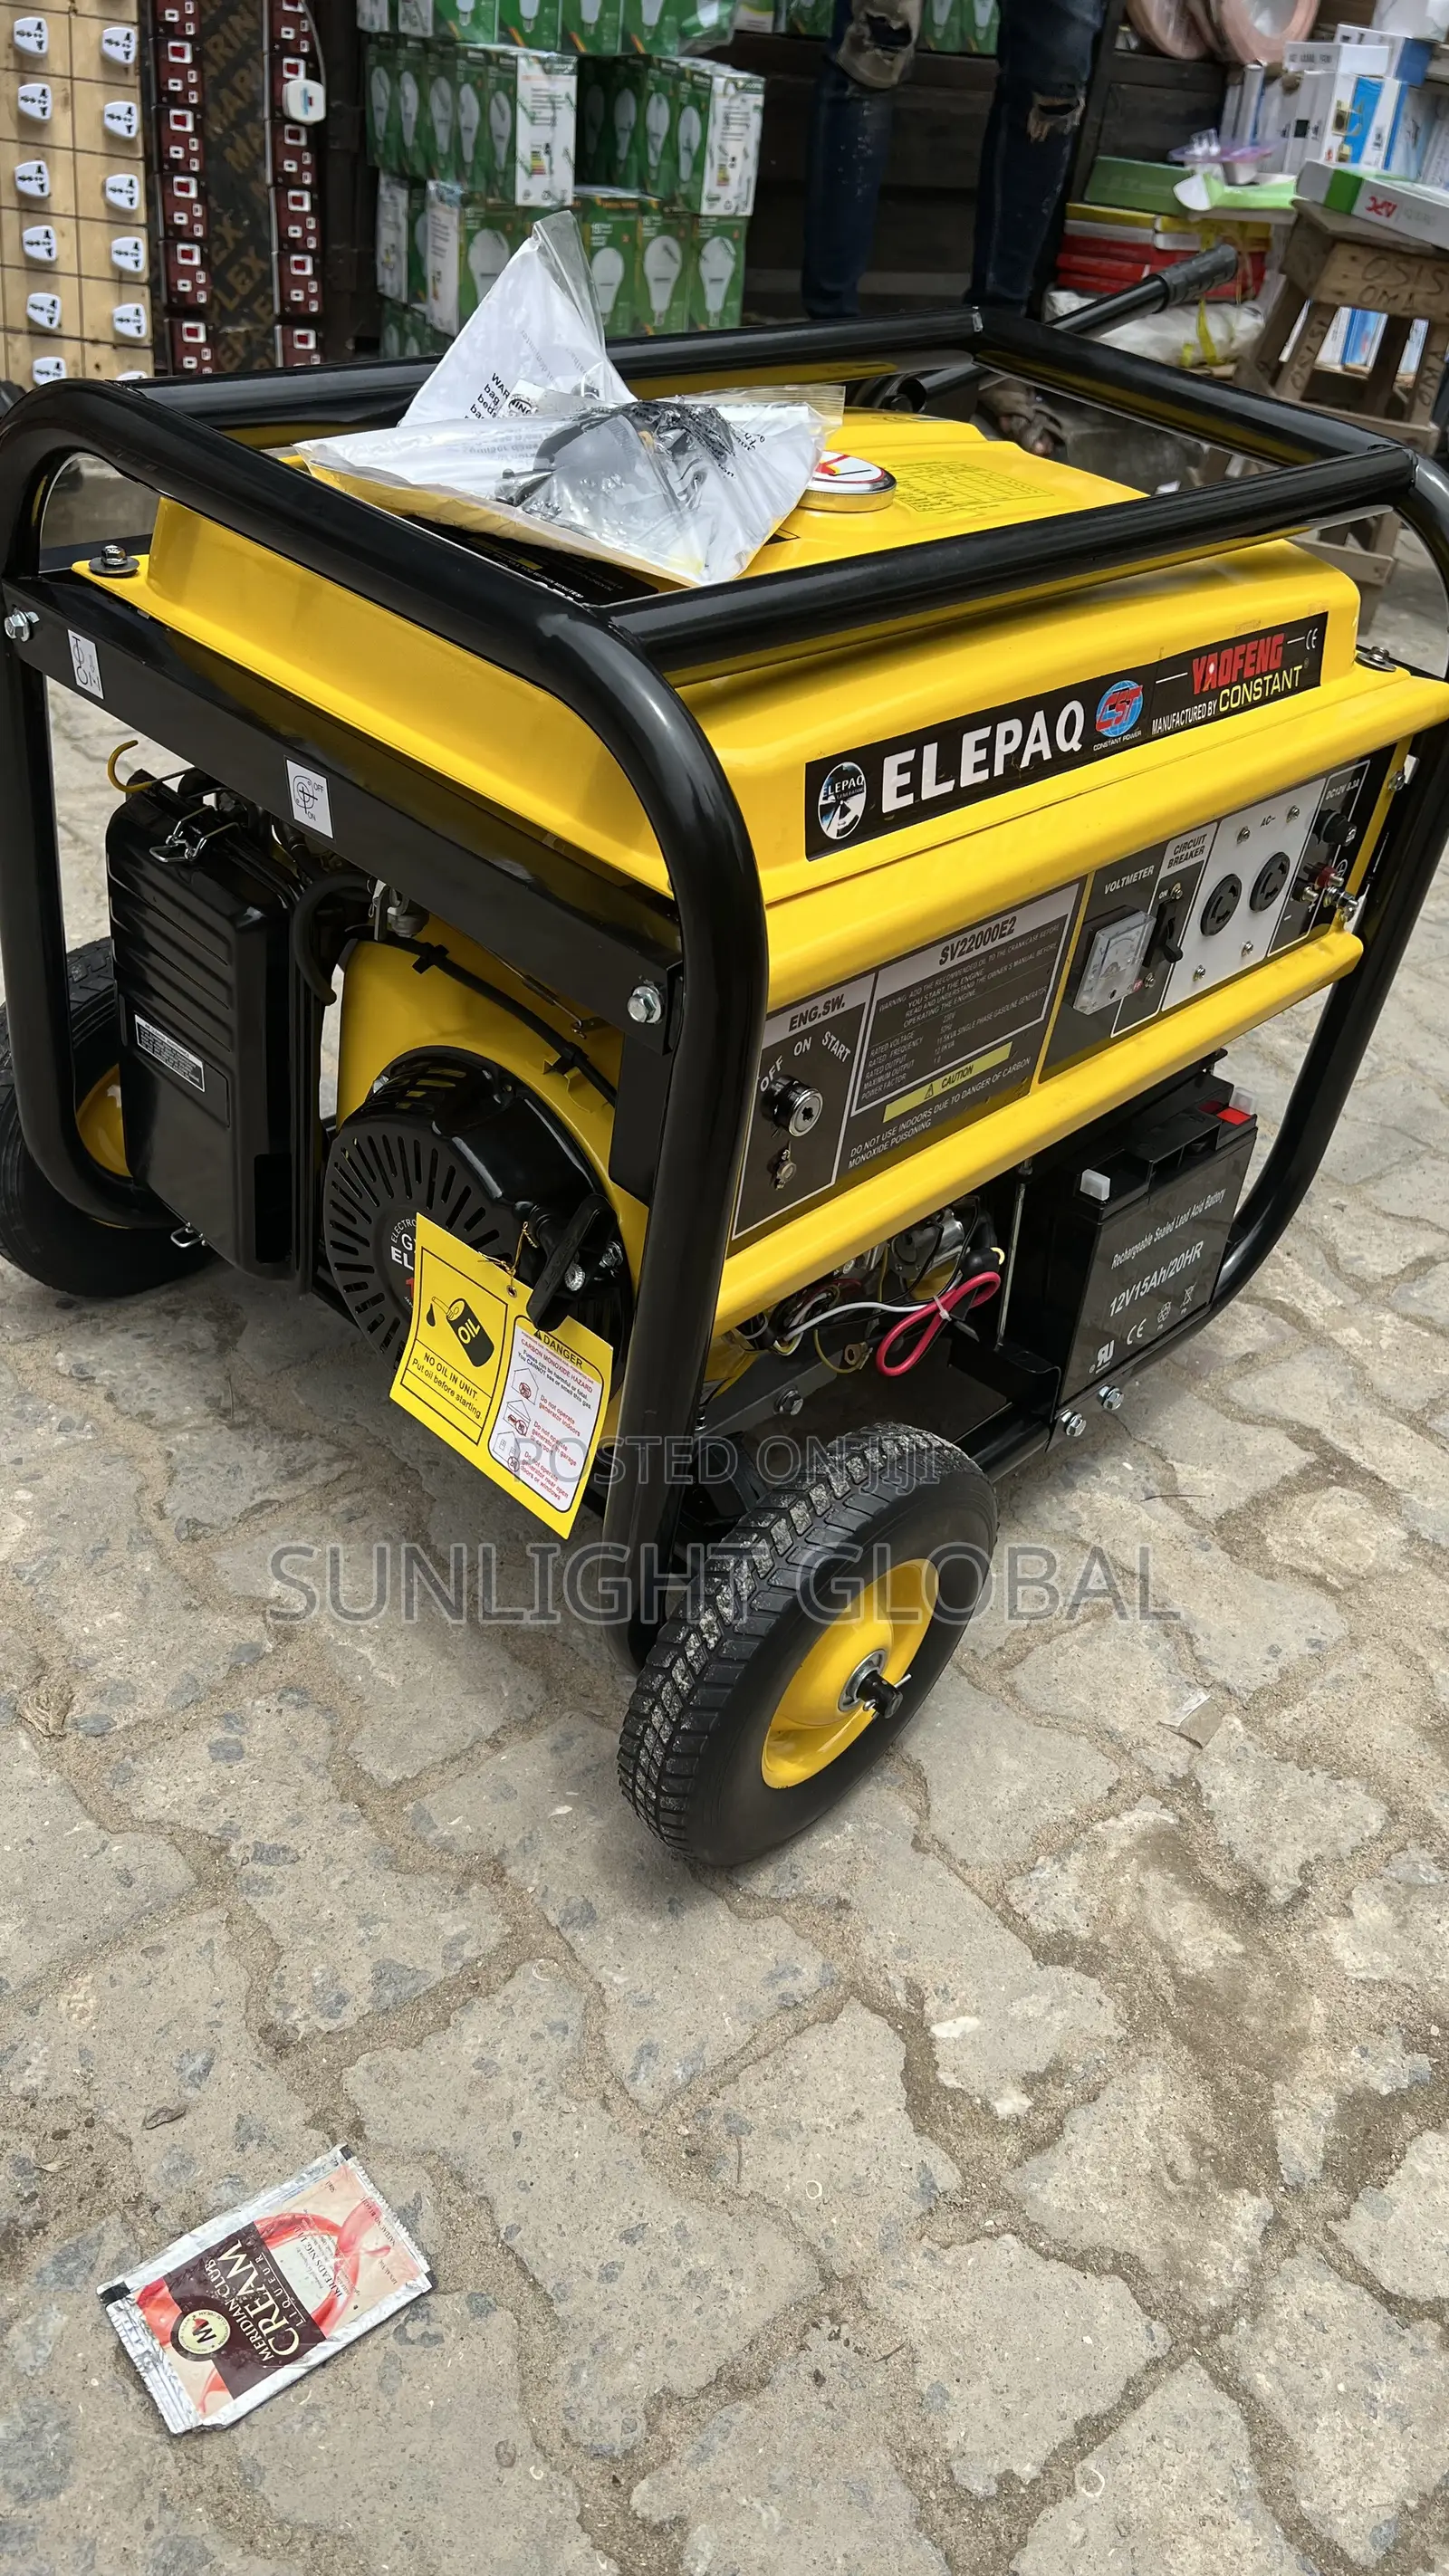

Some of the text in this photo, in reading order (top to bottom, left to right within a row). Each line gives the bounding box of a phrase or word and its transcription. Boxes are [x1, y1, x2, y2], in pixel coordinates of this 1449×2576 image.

[1192, 633, 1285, 694] YAOFENG
[1152, 665, 1302, 735] MANUFACTURED BY CONSTANT
[881, 700, 1085, 813] ELEPAQ
[1093, 730, 1141, 752] CONSTANT POWER
[313, 782, 324, 793] OFF
[823, 774, 864, 797] ELEPAQ
[308, 811, 316, 821] ON
[1167, 846, 1205, 869] BREAKER
[1173, 834, 1207, 856] CIRCUIT
[1105, 865, 1155, 895] VOLTMETER
[1159, 889, 1168, 899] ON
[939, 916, 1016, 965] SV22000E2
[906, 1005, 922, 1018] READ
[923, 999, 936, 1010] AND
[936, 982, 975, 1005] UNDERSTAND
[976, 975, 987, 986] THE
[908, 995, 924, 1008] YOU
[924, 988, 945, 1003] START
[947, 982, 959, 993] THE
[788, 993, 845, 1032] ENG.SW.
[904, 1006, 940, 1028] OPERATING
[941, 1001, 952, 1011] THE
[793, 1037, 812, 1057] ON
[821, 1030, 851, 1062] START
[865, 1067, 884, 1079] RATED
[885, 1054, 907, 1070] OUTPUT
[956, 1021, 975, 1038] SINGLE
[976, 1013, 993, 1027] PHASE
[870, 1045, 888, 1058] RATED
[889, 1031, 916, 1049] VOLTAGE
[890, 1037, 924, 1058] FREQUENCY
[760, 1055, 783, 1092] OFF
[863, 1059, 915, 1089] MAXIMUM OUTPUT
[883, 1073, 907, 1090] FACTOR
[941, 1064, 974, 1089] CAUTION
[850, 1056, 1032, 1158] DO NOT USE INDOORS DUE TO DANGER OF CARBON
[848, 1119, 932, 1169] MONOXIDE POISONING
[1111, 1188, 1227, 1269] Rechargeable Sealed Lead Acid Battery
[1110, 1240, 1204, 1317] 12V15Ah/20HR
[457, 1318, 481, 1345] OIL
[521, 1338, 593, 1393] CARBON MONOXIDE HAZARD
[523, 1349, 538, 1364] Fumes
[547, 1365, 553, 1374] be
[553, 1370, 571, 1387] harmful
[543, 1335, 583, 1369] DANGER
[411, 1358, 424, 1373] Put
[424, 1365, 435, 1379] oil
[433, 1372, 456, 1398] before
[424, 1352, 435, 1365] NO
[436, 1360, 449, 1378] OIL
[449, 1373, 458, 1386] IN
[526, 1358, 546, 1376] CANNOT
[546, 1374, 555, 1383] see
[561, 1384, 572, 1397] smell
[573, 1393, 582, 1403] this
[539, 1403, 581, 1437] generator indoors
[547, 1400, 557, 1410] not
[557, 1409, 575, 1424] operate
[534, 1421, 569, 1451] Do not operate
[540, 1464, 559, 1482] operate
[560, 1449, 577, 1466] garage
[520, 1465, 561, 1500] doors or windows
[545, 1477, 556, 1487] near
[555, 1484, 569, 1499] open
[217, 2239, 300, 2356] CREAM
[254, 2254, 304, 2328] LIQUEUR
[204, 2258, 274, 2362] MERIDIAN CLUB
